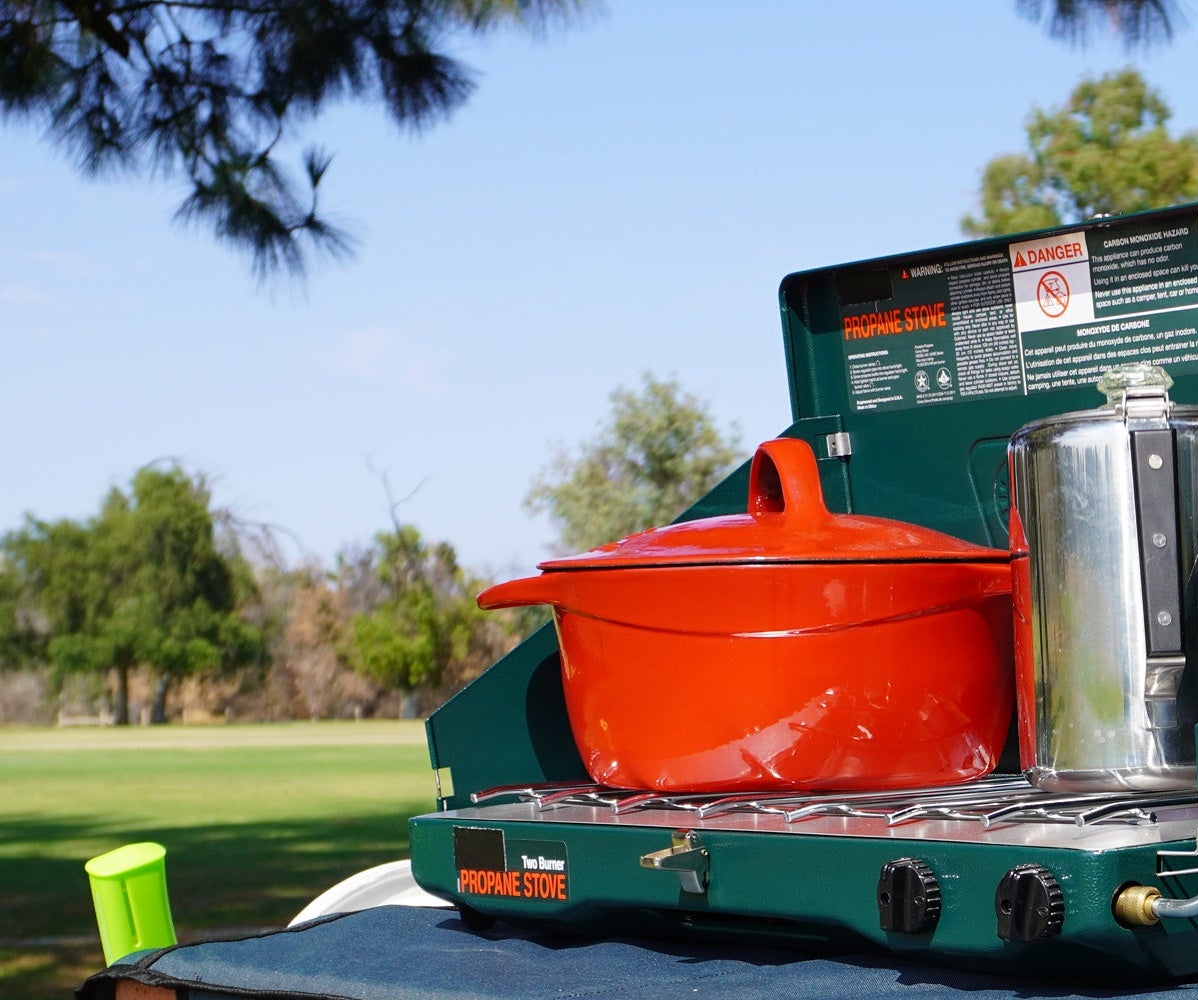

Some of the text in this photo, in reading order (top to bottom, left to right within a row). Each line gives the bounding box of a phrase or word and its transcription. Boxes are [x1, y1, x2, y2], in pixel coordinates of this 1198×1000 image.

[1104, 228, 1188, 248] CARBON MONOXIDE HAZARD
[1028, 243, 1083, 264] DANGER
[1104, 252, 1128, 262] appliance
[1140, 247, 1162, 256] produce
[1164, 243, 1182, 251] carbon
[909, 263, 944, 278] WARNING:
[1120, 260, 1136, 268] which
[1128, 270, 1152, 280] enclosed
[1153, 269, 1169, 277] space
[1181, 264, 1189, 272] kill
[1132, 284, 1158, 293] appliance
[1173, 277, 1198, 287] enclosed
[1096, 300, 1111, 308] space
[1112, 297, 1124, 305] such
[844, 302, 947, 340] PROPANE STOVE
[1077, 320, 1150, 336] MONOXYDE DE CARBONE
[1034, 346, 1054, 355] appareil
[1055, 345, 1066, 353] peut
[1067, 343, 1088, 352] produire
[1097, 337, 1124, 346] monoxyde
[1164, 331, 1174, 339] gaz
[1072, 354, 1092, 363] appareil
[1152, 345, 1164, 353] peut
[1078, 366, 1098, 375] appareil
[1152, 358, 1172, 366] comme
[522, 855, 564, 871] Two Burner
[460, 870, 567, 900] PROPANE STOVE
